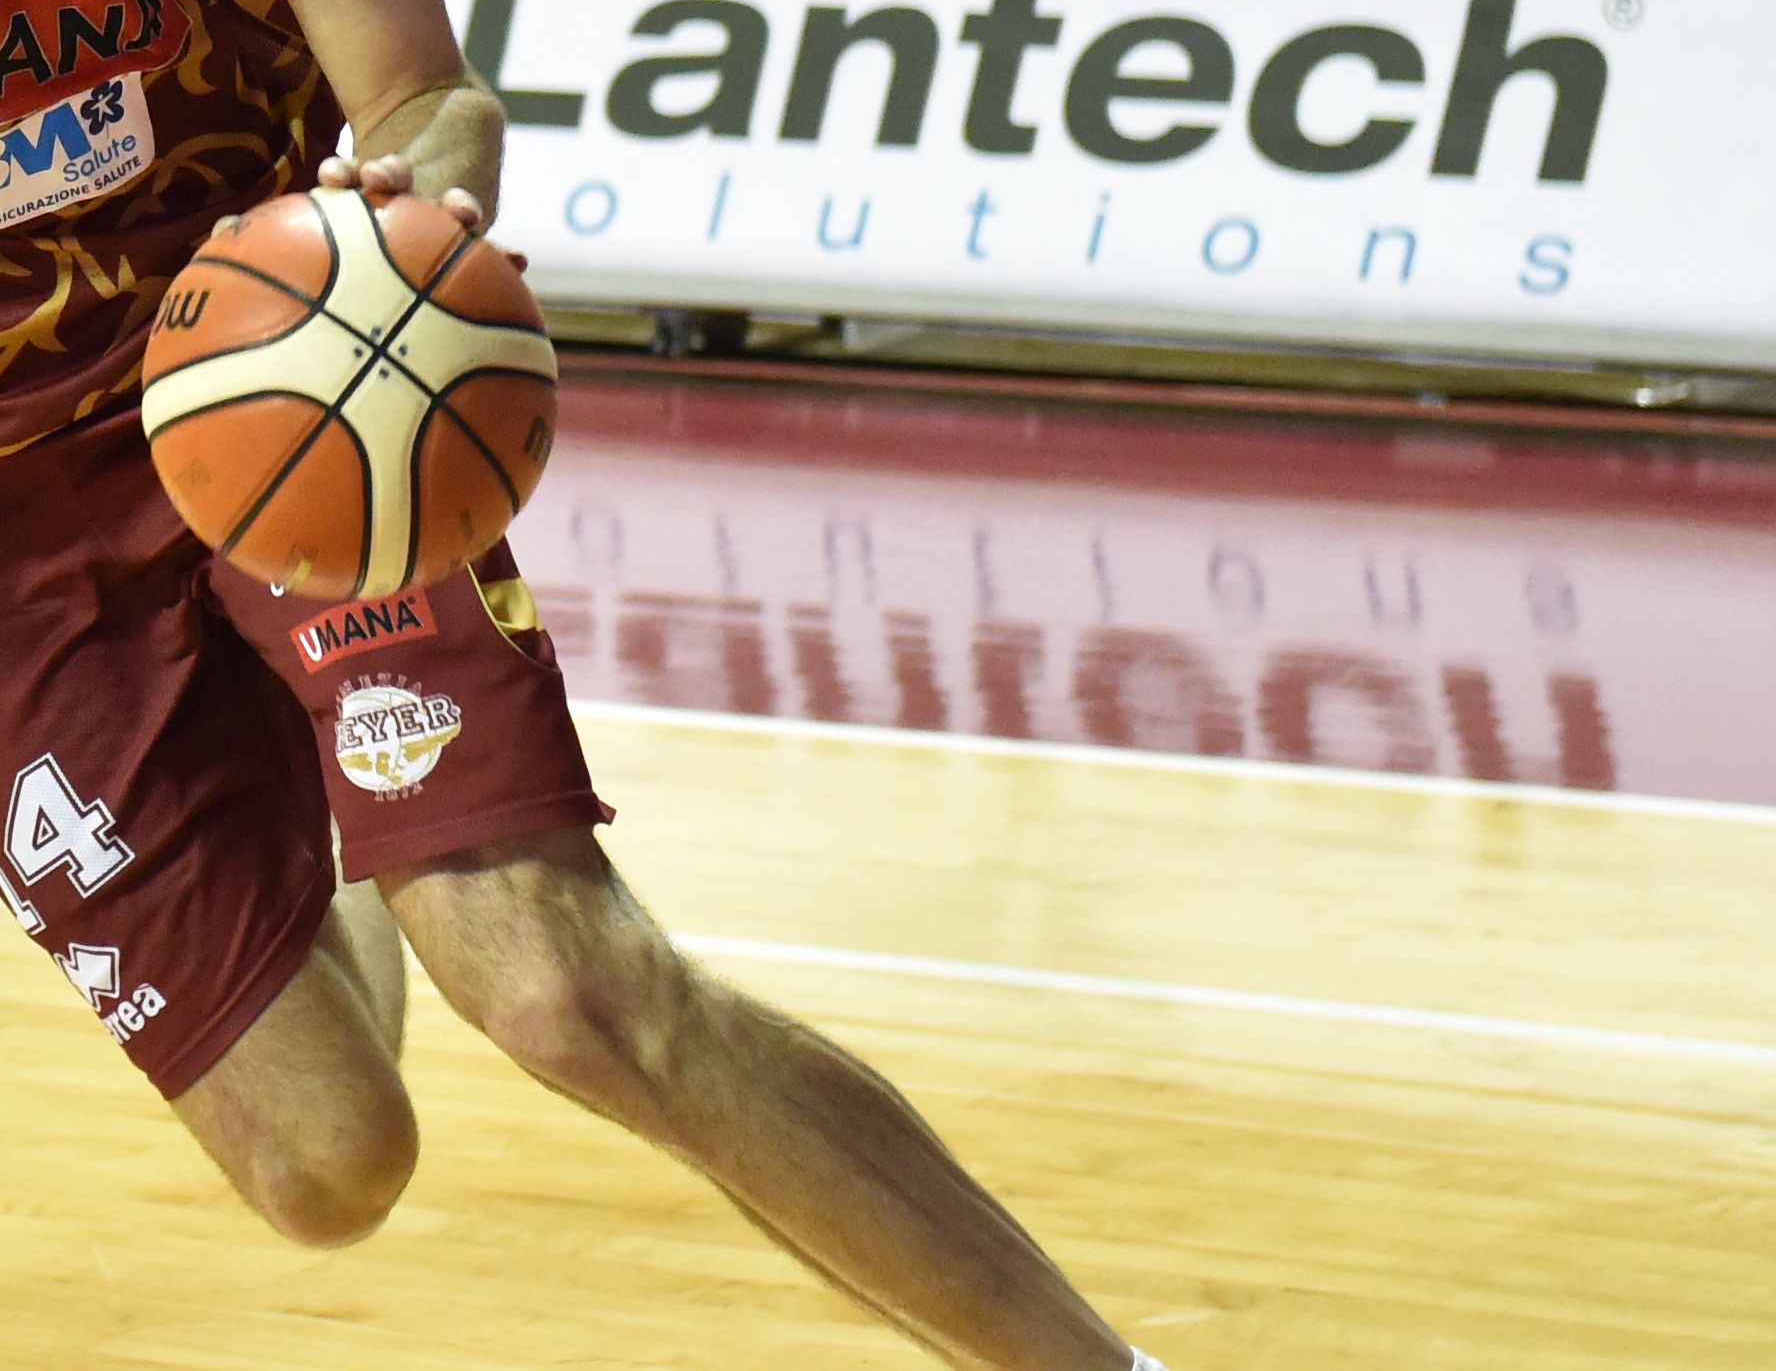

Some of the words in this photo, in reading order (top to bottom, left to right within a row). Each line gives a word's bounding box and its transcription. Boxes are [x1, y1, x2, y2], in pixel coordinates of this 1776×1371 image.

[63, 134, 137, 183] Salute
[94, 155, 142, 192] SALUTE
[564, 171, 1576, 296] olutions
[299, 600, 422, 662] UMANA
